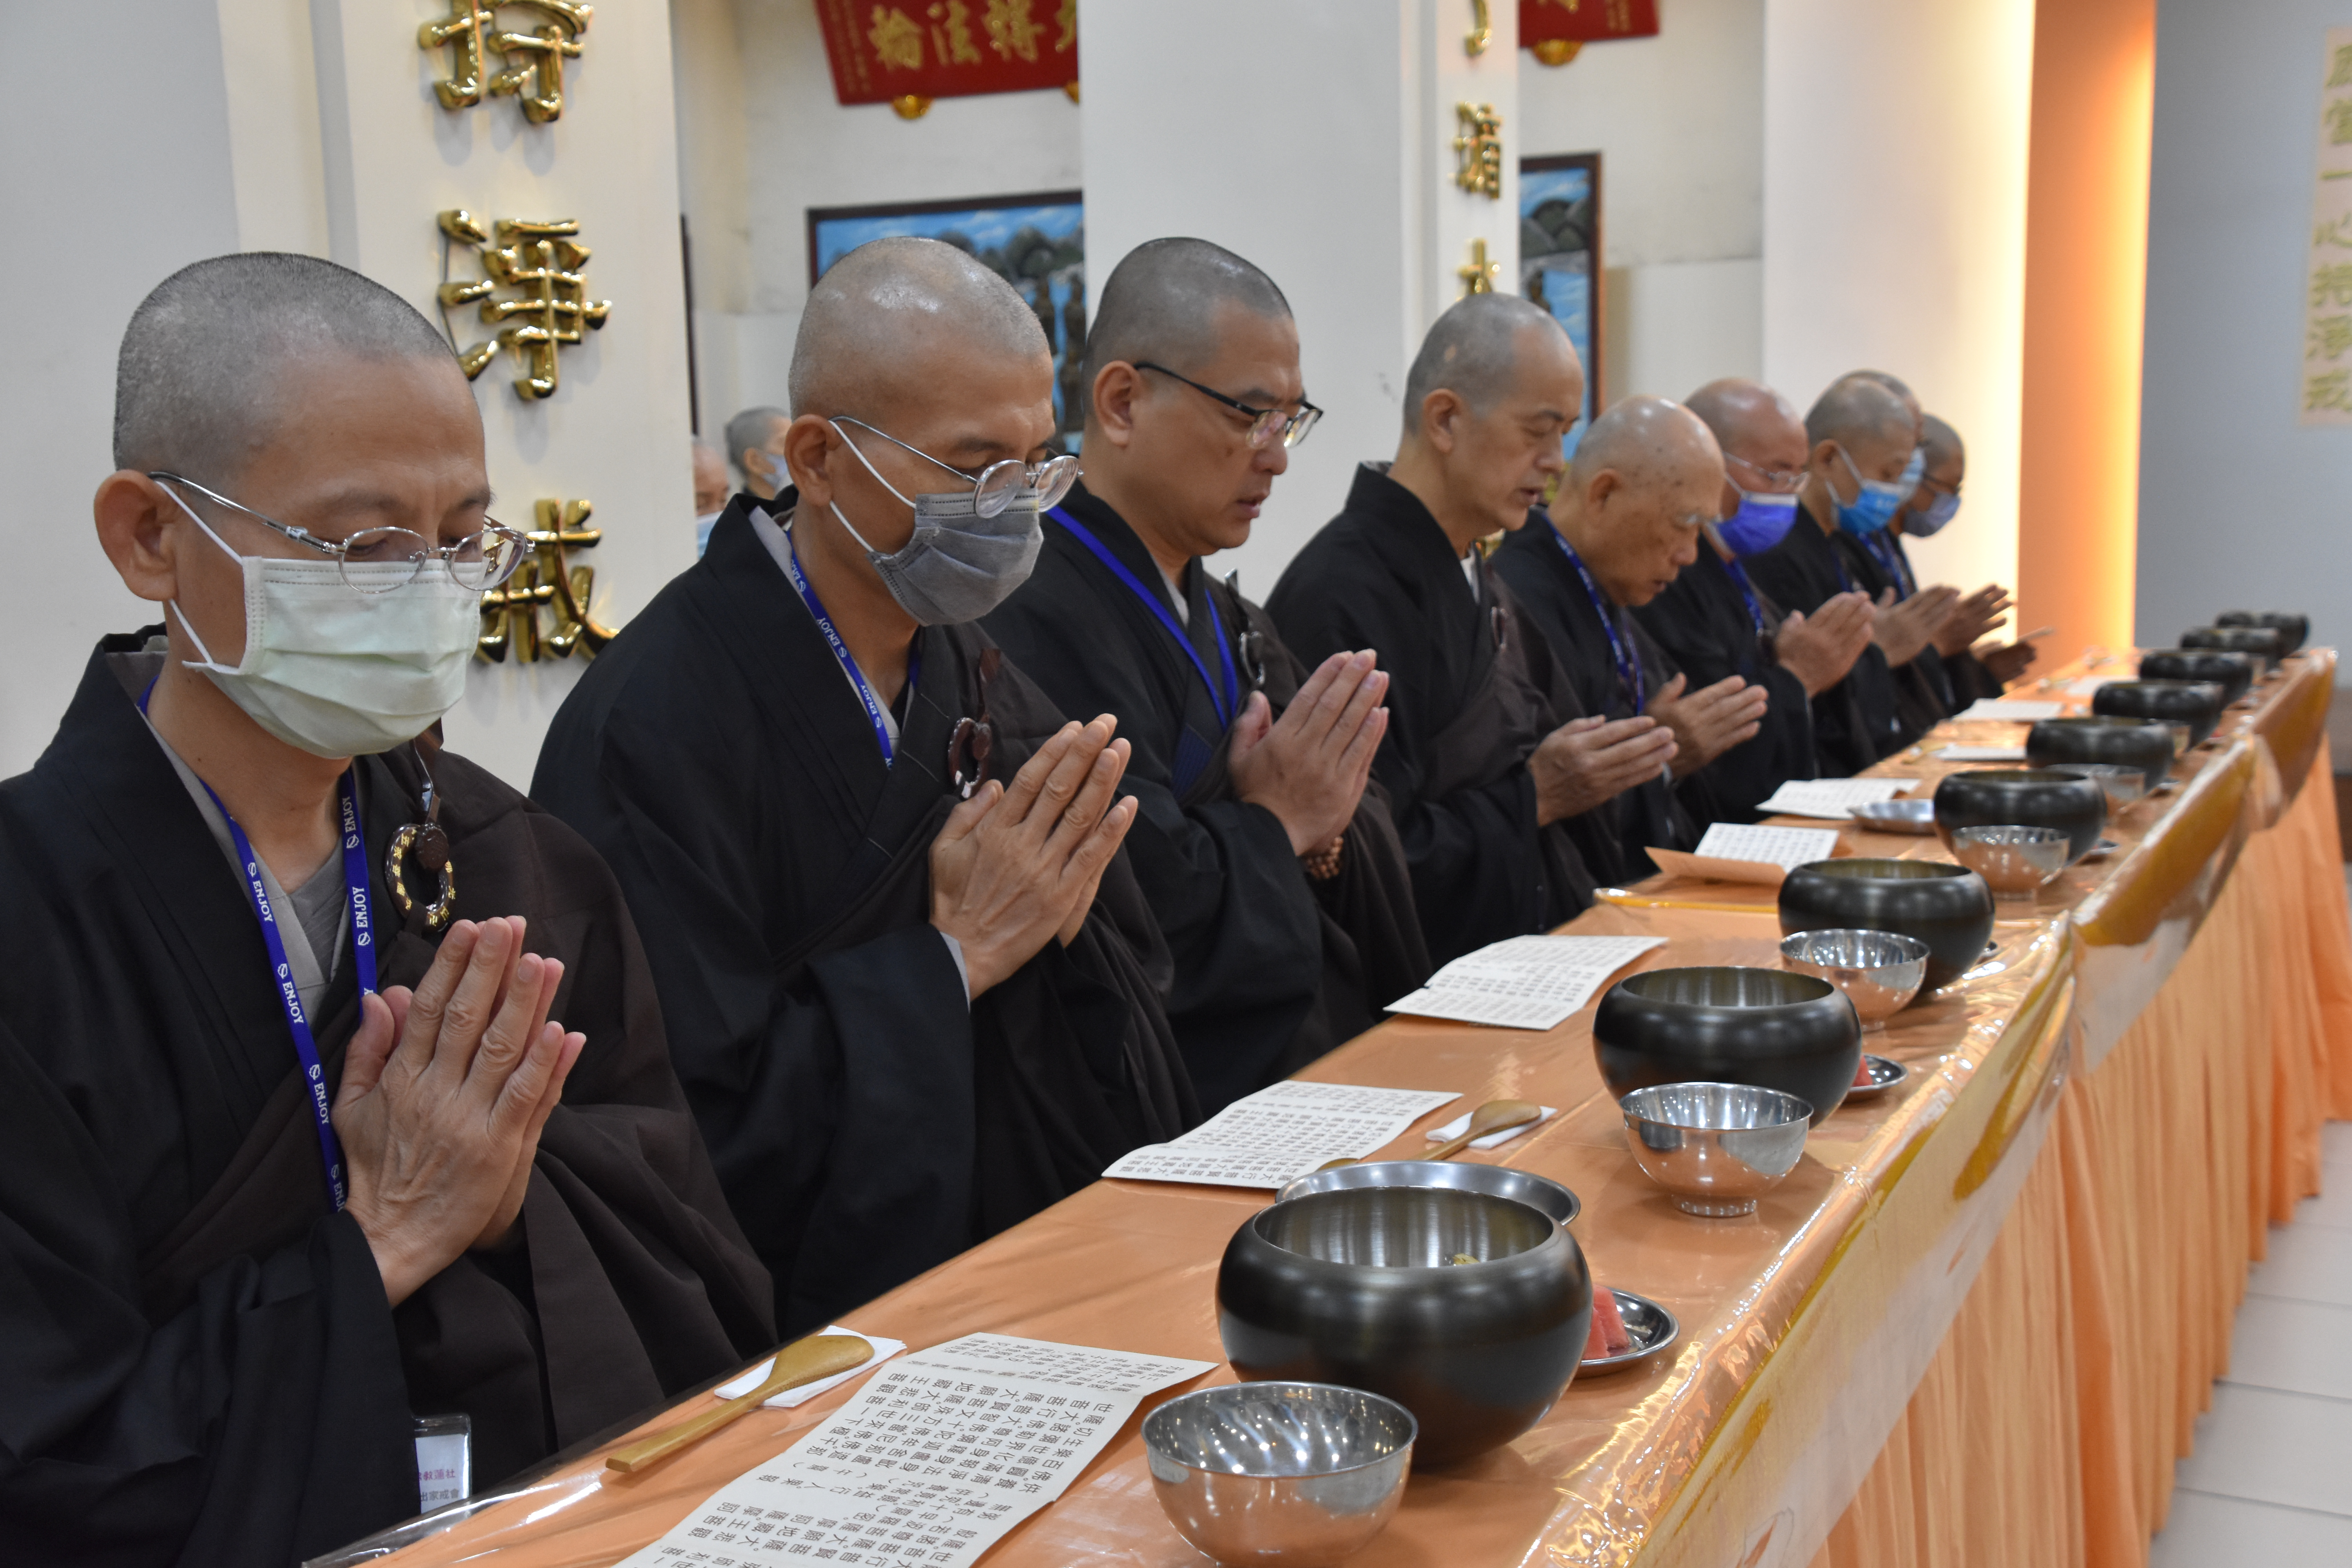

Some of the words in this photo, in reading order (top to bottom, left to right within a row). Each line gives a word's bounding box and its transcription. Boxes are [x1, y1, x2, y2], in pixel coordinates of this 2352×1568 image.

[817, 618, 840, 647] ENJOY
[860, 685, 877, 715] ENJOY
[342, 796, 356, 832] ENJOY
[253, 881, 273, 923] ENJOY
[352, 887, 368, 928] ENJOY
[282, 982, 304, 1024] ENJOY
[314, 1082, 330, 1125] ENJOY
[419, 1469, 456, 1481] 教蓮社
[662, 1548, 771, 1568] 殊師利菩
